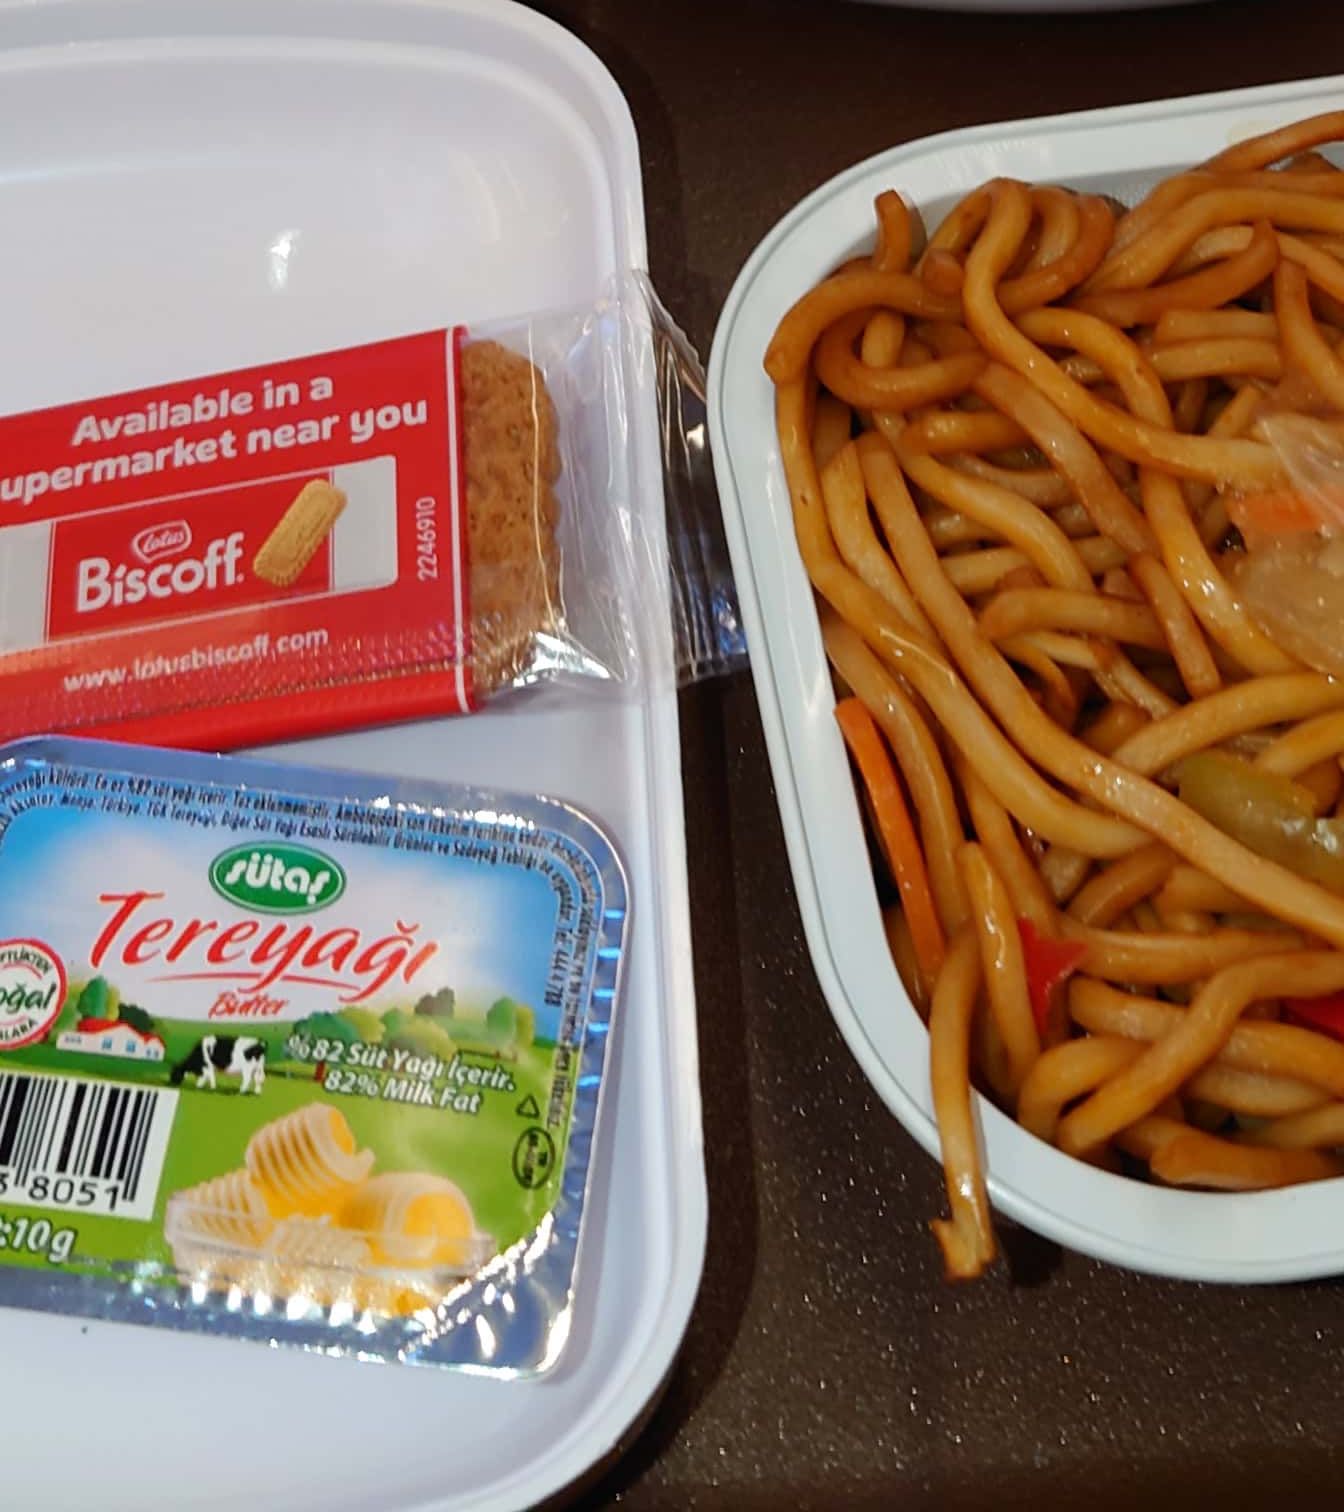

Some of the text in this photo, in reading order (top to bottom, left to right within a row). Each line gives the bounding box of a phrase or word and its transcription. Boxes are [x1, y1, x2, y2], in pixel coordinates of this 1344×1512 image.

[71, 376, 333, 447] Available in a
[247, 413, 340, 453] near
[351, 399, 428, 444] you
[416, 496, 438, 581] 2246910
[75, 531, 245, 613] Biscoff
[63, 628, 329, 691] www.lotusbiscoff.com
[89, 890, 439, 1003] Tereyağı
[208, 991, 289, 1019] Butter
[324, 1069, 482, 1113] 82% Milk Fat
[346, 1042, 386, 1068] Süt
[392, 1049, 444, 1081] Yağı
